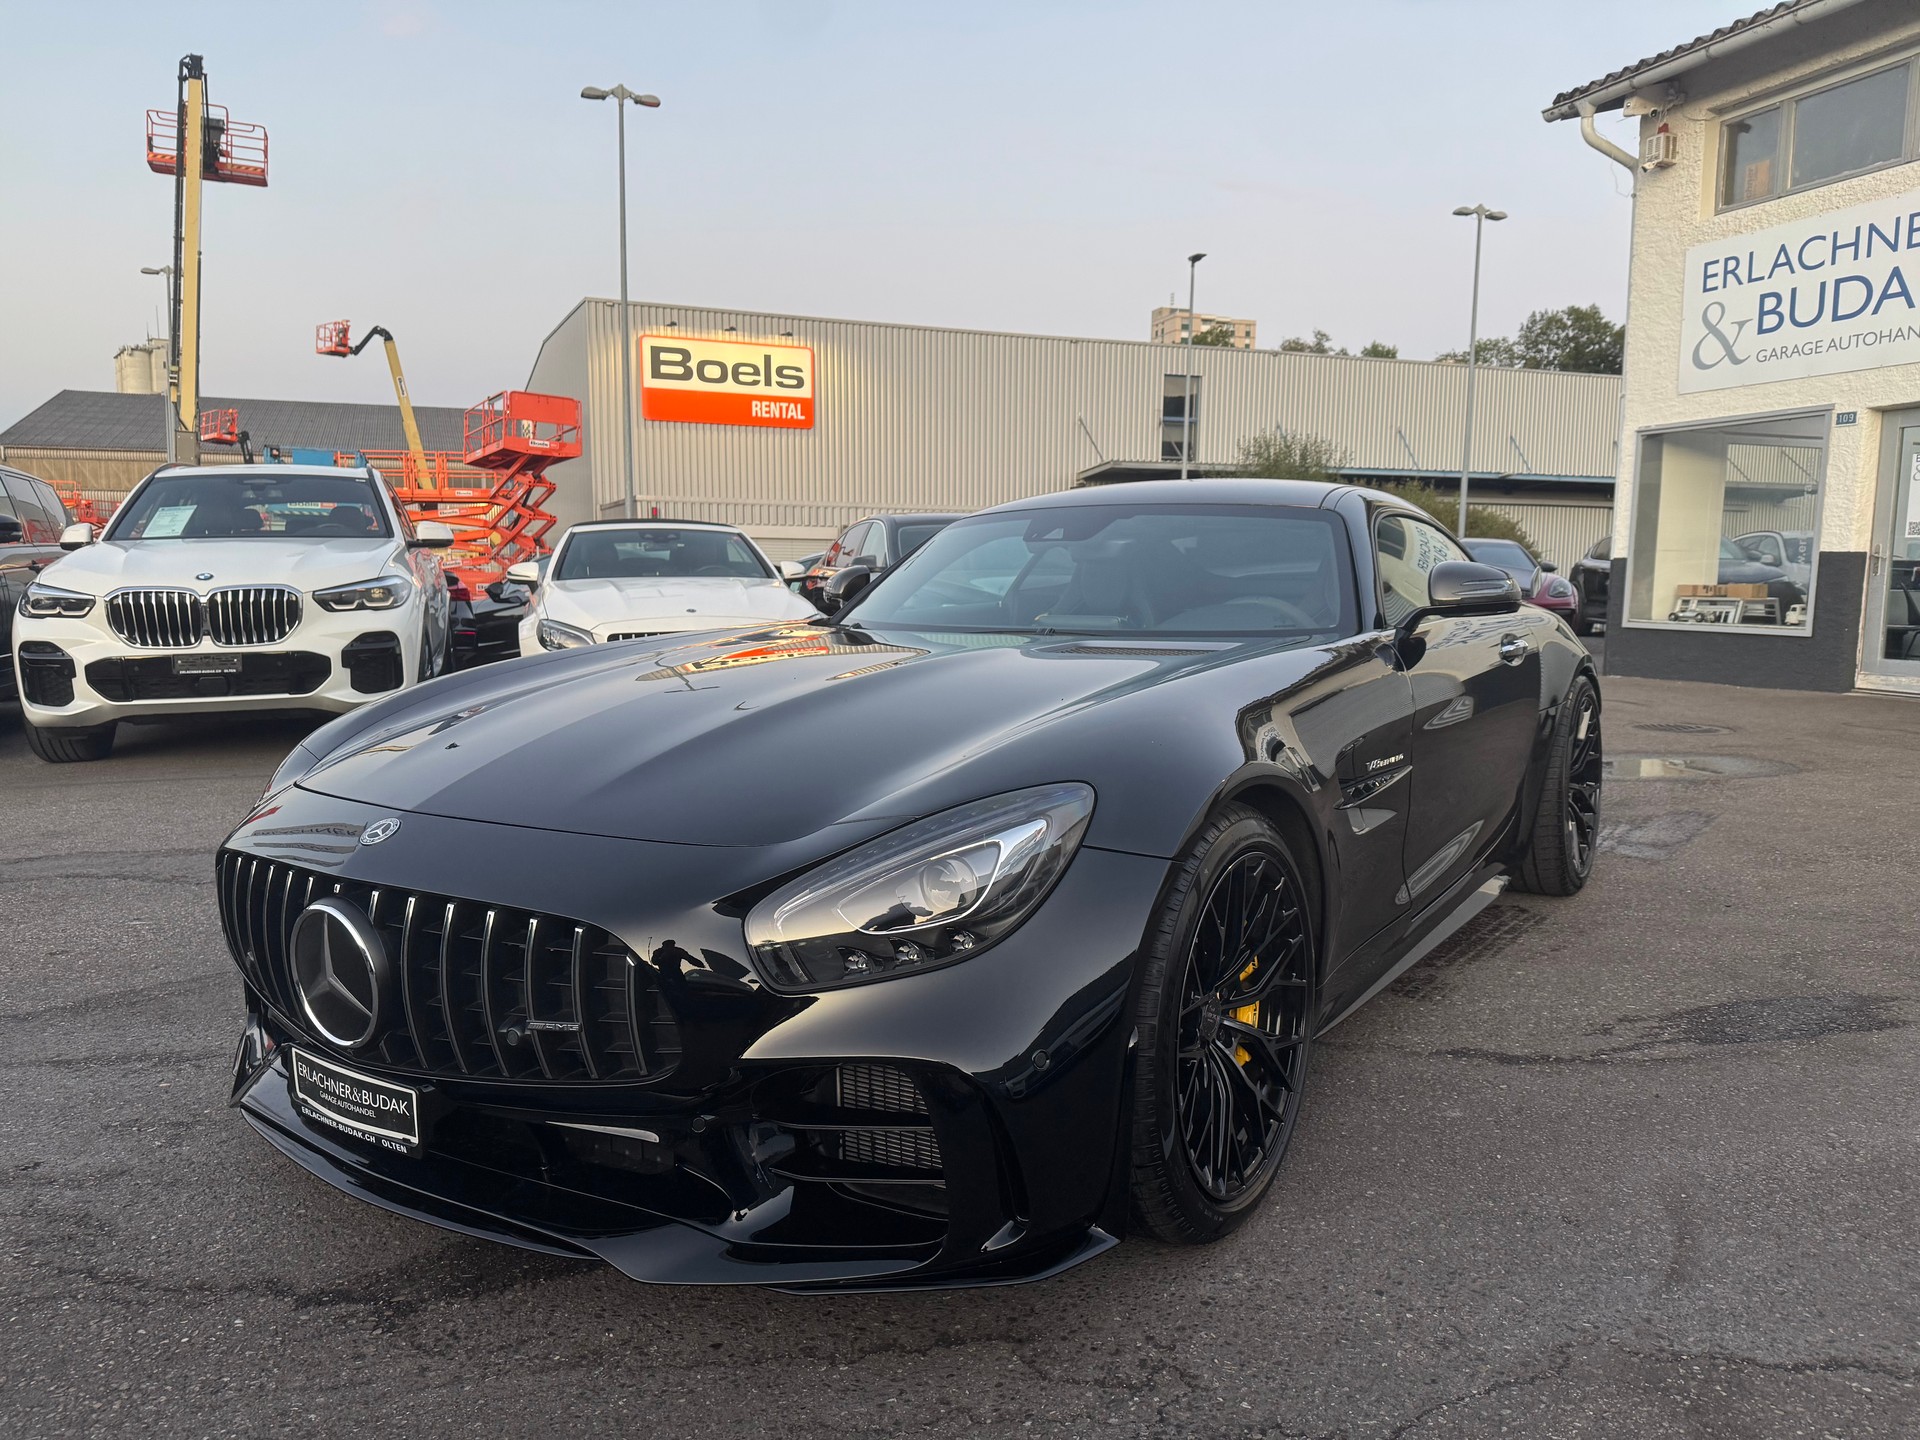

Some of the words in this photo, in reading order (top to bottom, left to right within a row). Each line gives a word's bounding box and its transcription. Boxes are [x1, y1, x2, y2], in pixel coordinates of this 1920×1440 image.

[1702, 211, 1920, 293] ERLACHNE
[1692, 301, 1753, 370] &
[1757, 266, 1915, 335] BUDA
[1756, 339, 1823, 363] GARAGE
[1826, 325, 1920, 352] AUTOHAN
[650, 345, 805, 390] Boels
[752, 400, 806, 420] RENTAL
[1839, 413, 1854, 423] 109
[298, 1061, 410, 1117] ERLACHNER&BUDAK
[319, 1089, 338, 1106] GARAGE
[301, 1106, 376, 1144] ERLACHNER-BUDAK.CH
[381, 1138, 408, 1154] OLTEN
